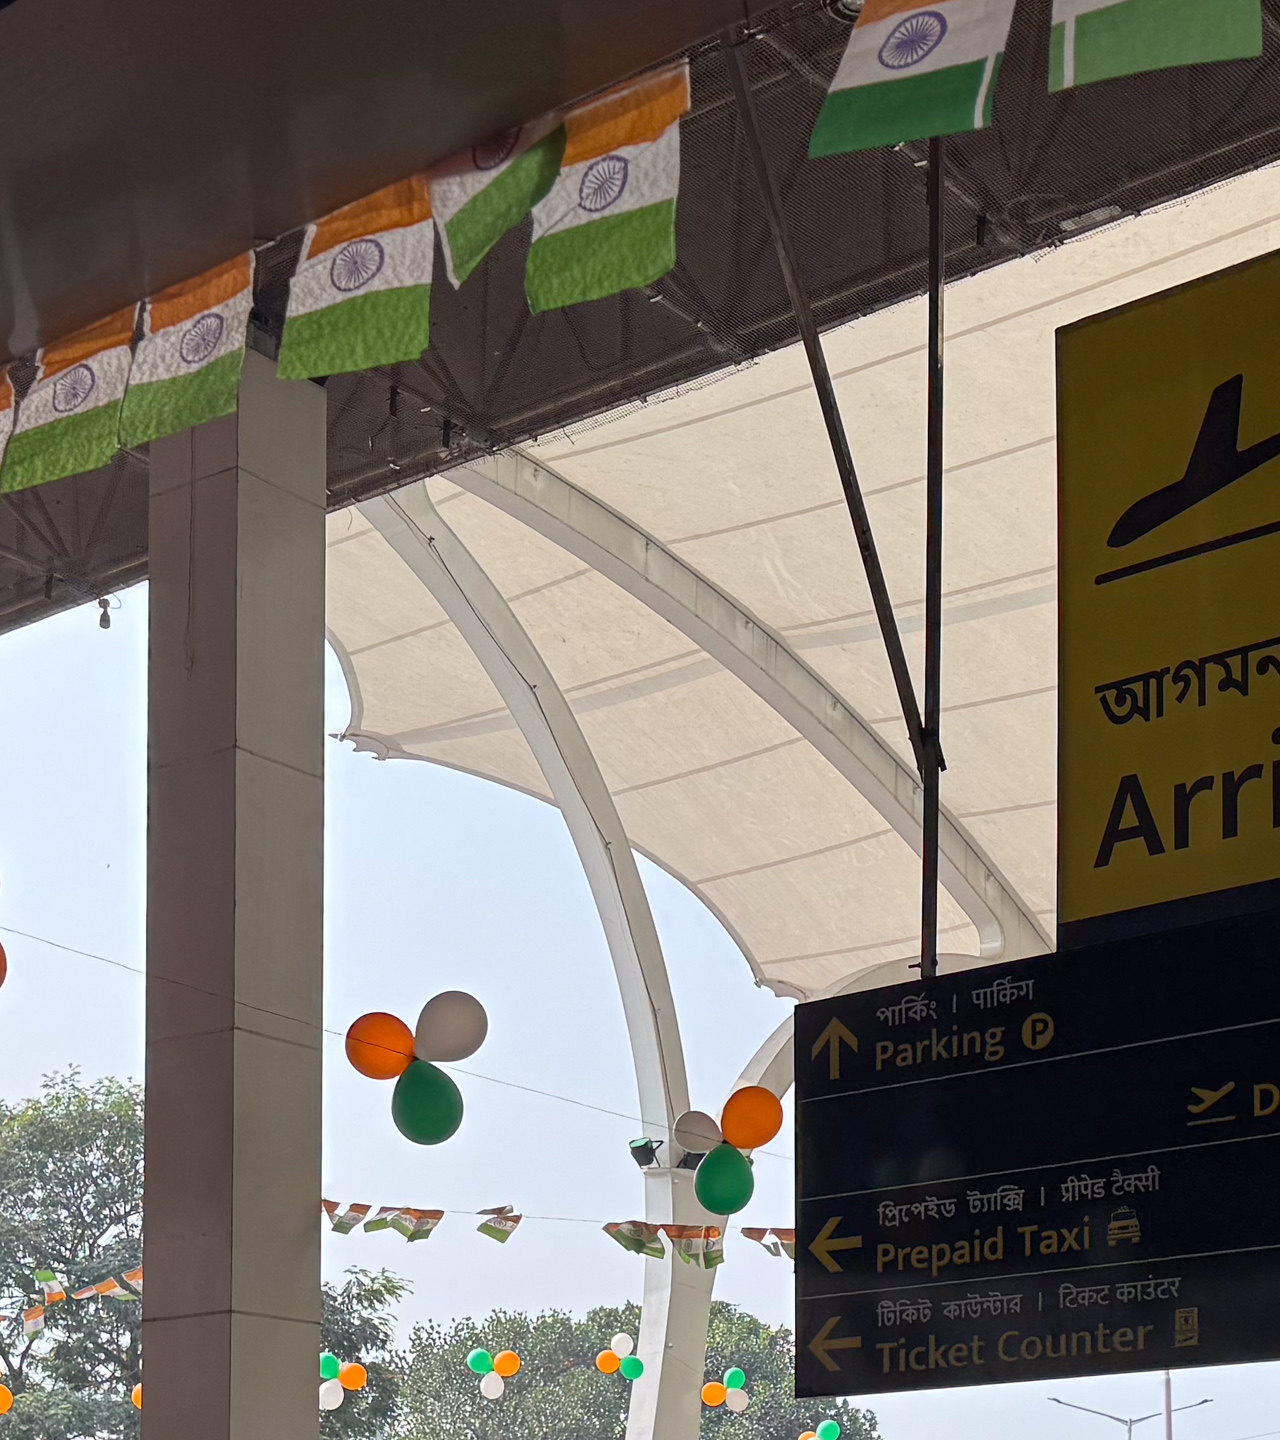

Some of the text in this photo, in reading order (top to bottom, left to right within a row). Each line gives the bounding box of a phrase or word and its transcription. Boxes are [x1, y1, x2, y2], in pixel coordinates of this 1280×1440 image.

[876, 992, 937, 1027] পার্কিং
[972, 976, 1035, 1009] पार्किंग
[875, 1024, 1006, 1071] Parking
[1060, 1165, 1162, 1204] प्रीपेड टैक्सी
[876, 1184, 1026, 1228] প্রিপেইড ট্যাক্সি
[876, 1215, 1091, 1277] Prepaid Taxi
[876, 1291, 1023, 1328] টিকিট কাউন্টার
[1058, 1274, 1182, 1309] टिकट काउंटर
[876, 1322, 1154, 1374] Ticket Counter
